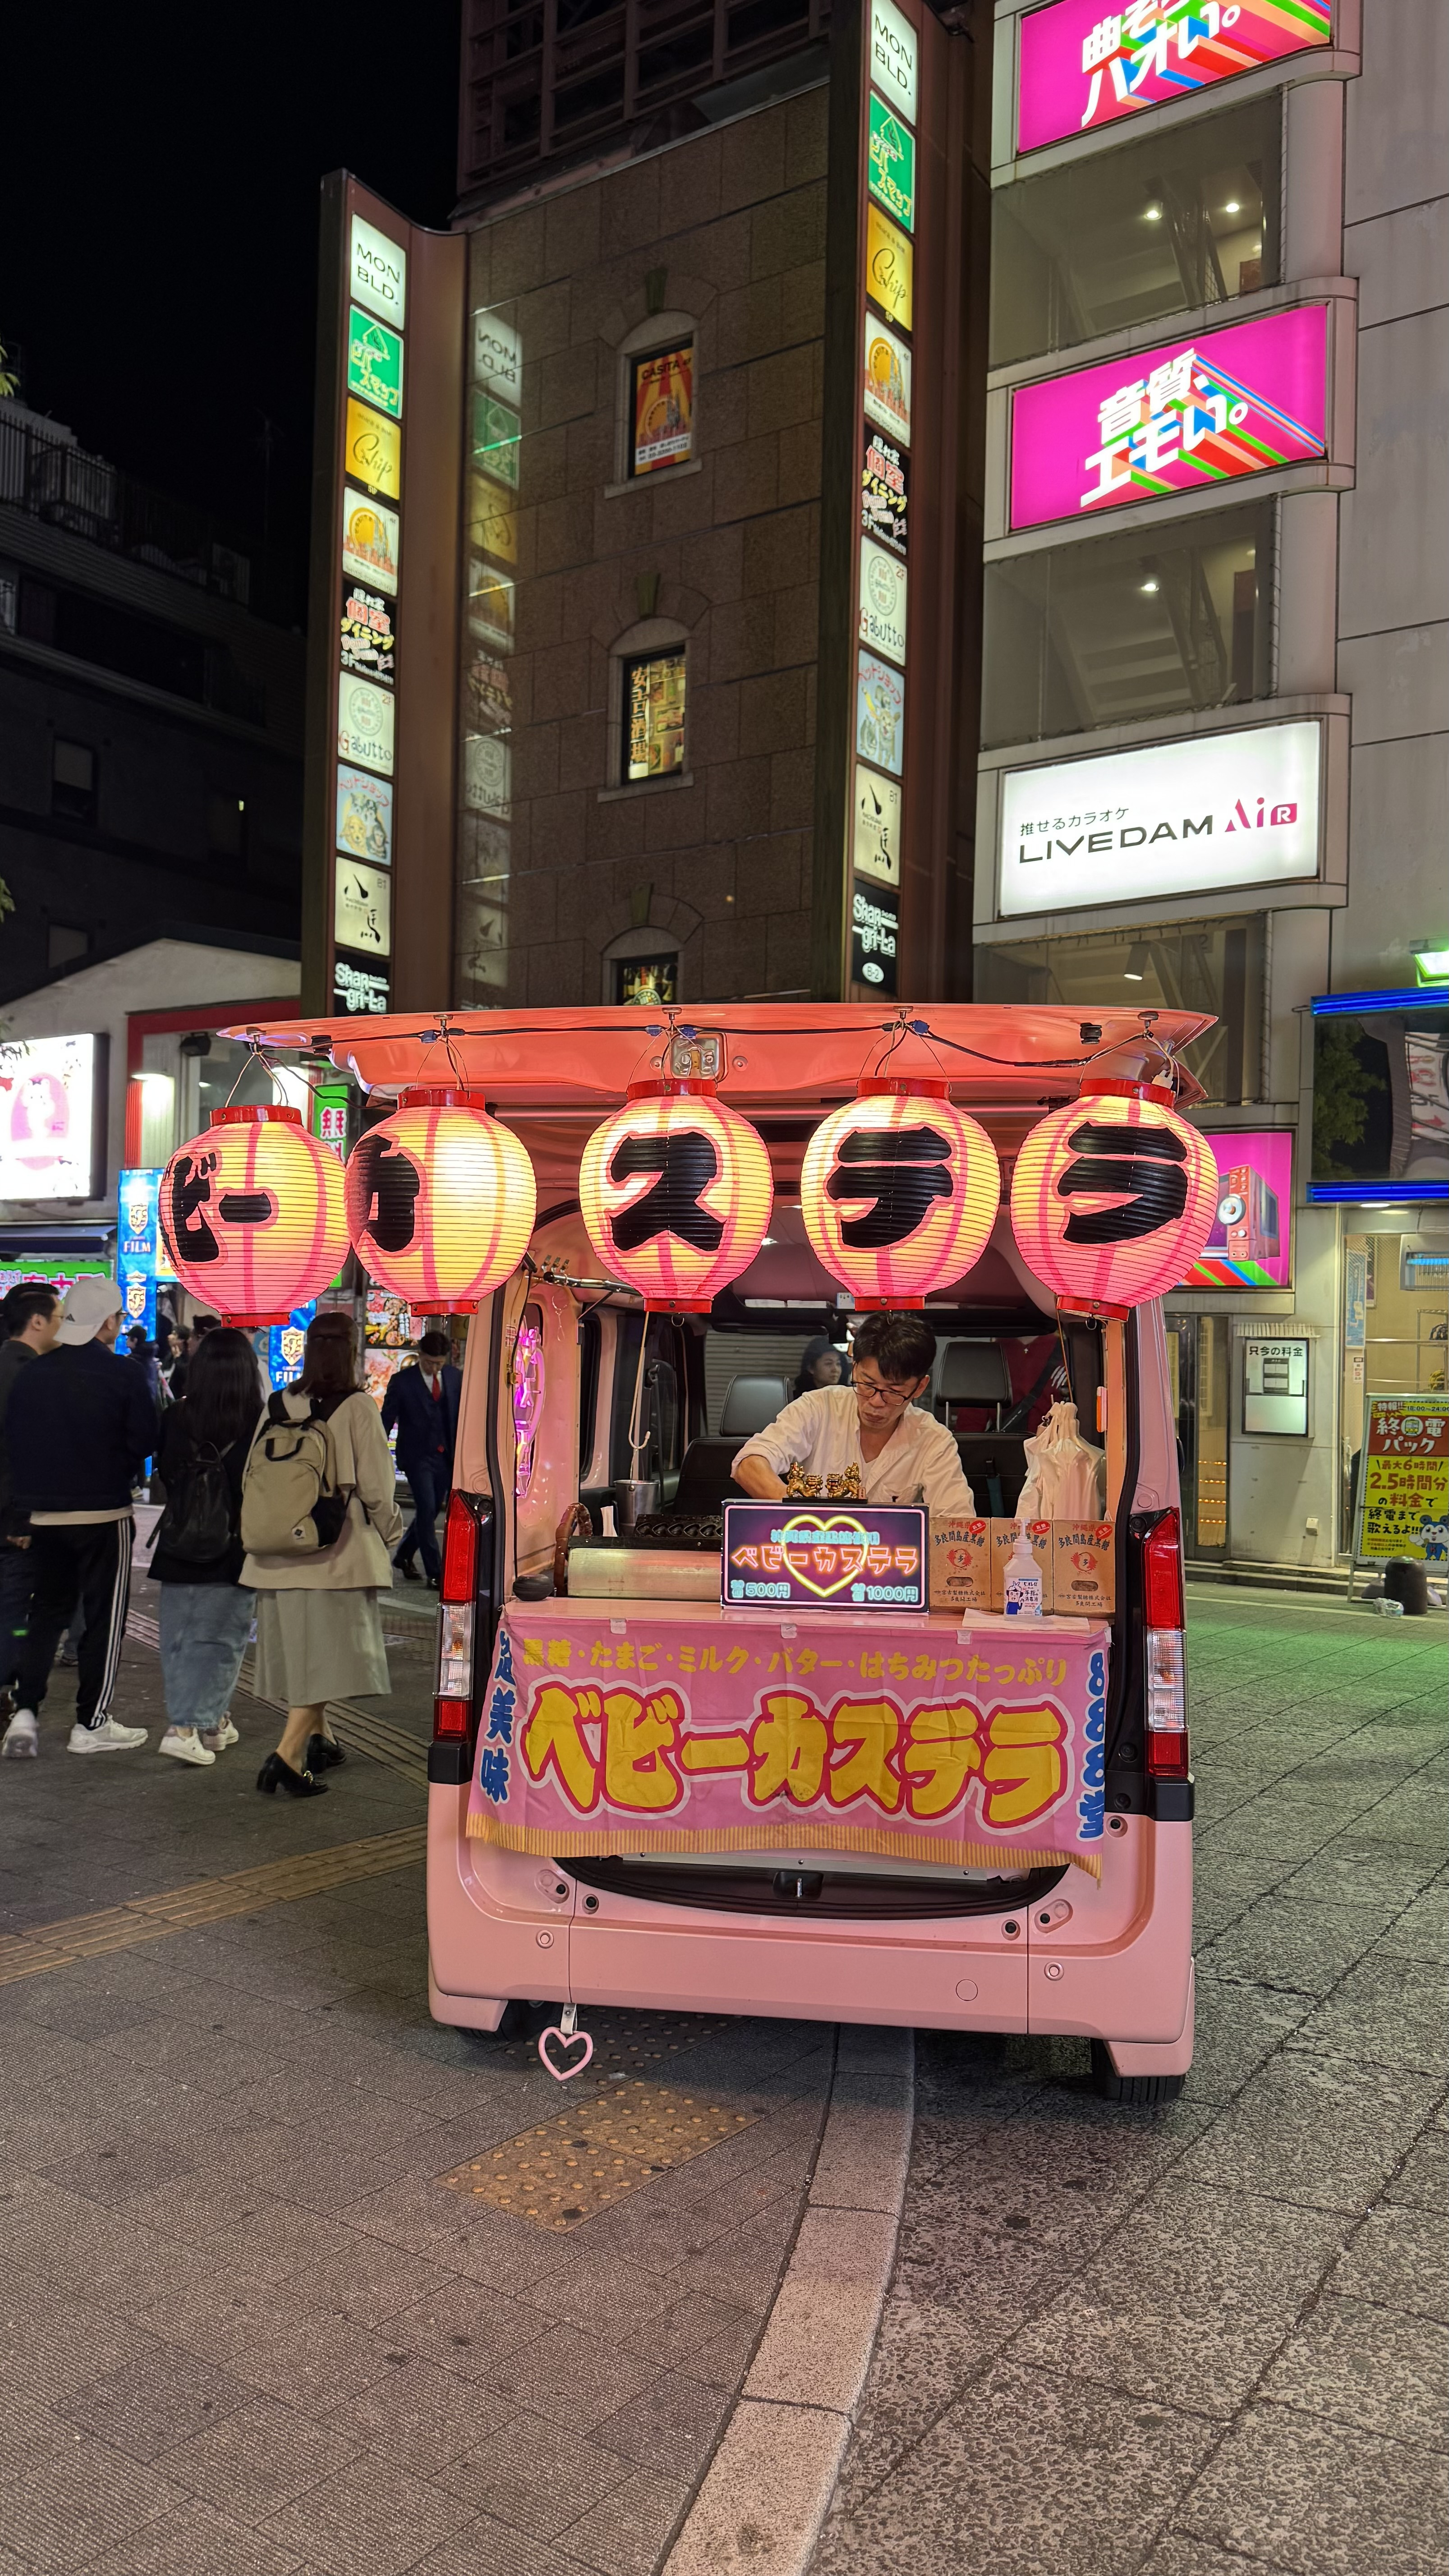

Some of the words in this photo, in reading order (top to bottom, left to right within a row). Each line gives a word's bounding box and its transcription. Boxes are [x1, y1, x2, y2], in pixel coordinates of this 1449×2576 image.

[875, 14, 912, 70] MON
[876, 41, 911, 96] BLD.
[357, 243, 400, 284] MON
[358, 265, 399, 305] BLD.
[1098, 348, 1210, 445] 音質、
[866, 445, 904, 495] 個室
[1081, 394, 1248, 508] エモい。
[862, 469, 907, 512] ダイニング
[861, 510, 874, 529] 3F
[340, 617, 395, 650] ダイニング
[346, 596, 390, 635] 個室
[860, 607, 904, 647] Gabutto
[341, 650, 355, 667] 3F
[339, 731, 392, 761] Gabutto
[1020, 807, 1130, 837] 推せるカラオケ
[611, 1131, 723, 1251] ス
[827, 1127, 953, 1249] テ
[1057, 1122, 1188, 1244] ラ
[124, 1241, 151, 1253] FILM
[1249, 1346, 1303, 1357] 只今の料金
[1382, 1436, 1435, 1454] パック
[1370, 1472, 1448, 1491] 2.5時間分
[1382, 1460, 1438, 1471] 最大6時間
[1368, 1509, 1420, 1521] 終電まで
[1378, 1492, 1438, 1508] の料金で
[731, 1546, 919, 1574] ベビーカステラ
[522, 1684, 1066, 1825] ベビーカステラ
